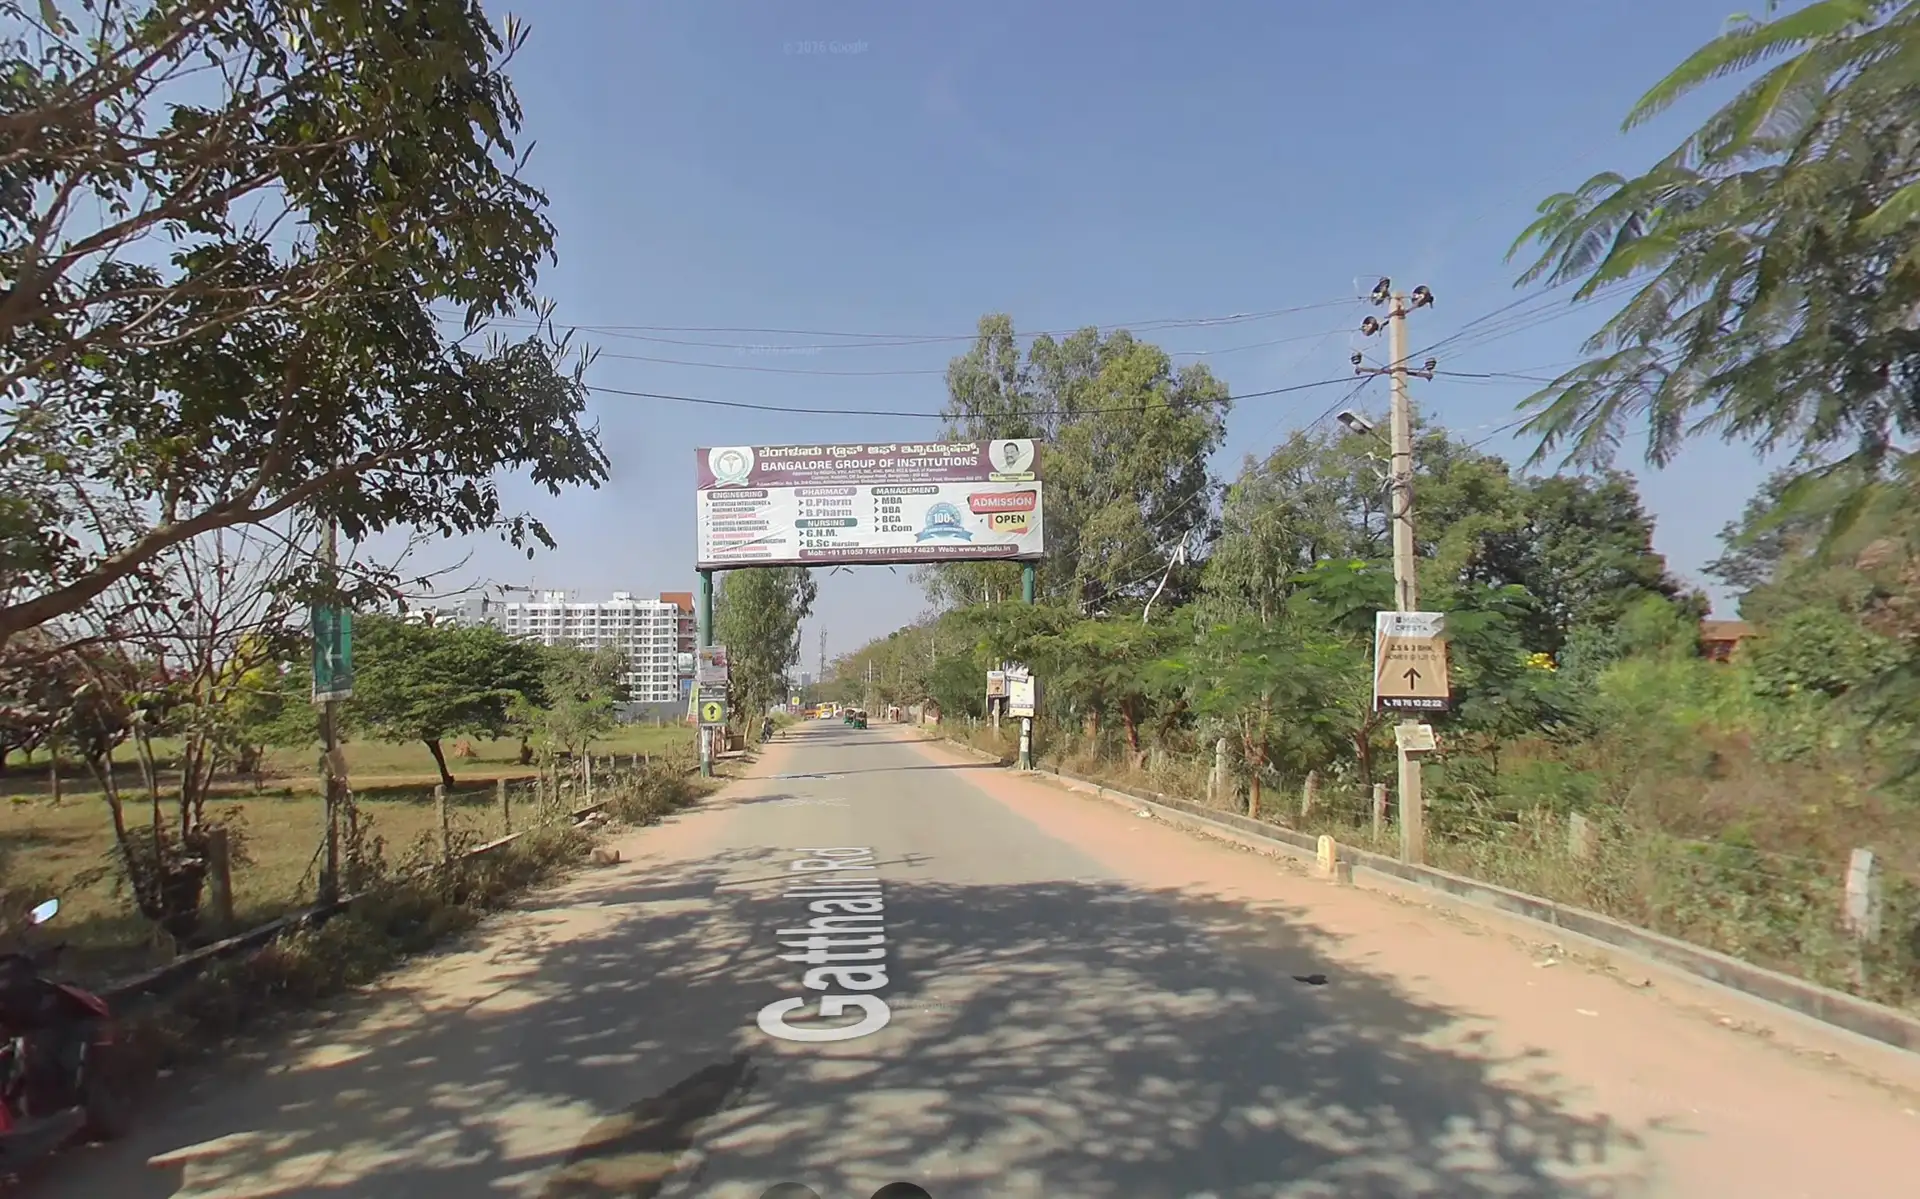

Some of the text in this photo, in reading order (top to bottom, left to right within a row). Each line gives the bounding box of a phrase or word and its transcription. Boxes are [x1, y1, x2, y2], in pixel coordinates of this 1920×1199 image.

[761, 456, 978, 471] BANGALORE GROUP OF INSTITUTIONS
[712, 490, 763, 499] ENGINEERING
[802, 488, 849, 496] PHARMACY
[876, 486, 936, 495] MANAGEMENT
[806, 498, 852, 507] D.Pharm
[882, 497, 902, 505] MBA
[973, 497, 1032, 507] ADMISSION
[806, 509, 852, 517] B.Pharm
[882, 506, 901, 514] BBA
[808, 519, 845, 527] NURSING
[882, 515, 901, 523] BCA
[995, 514, 1025, 524] OPEN
[882, 524, 912, 532] B.Com
[806, 529, 838, 537] G.N.M.
[806, 539, 830, 548] B.Sc
